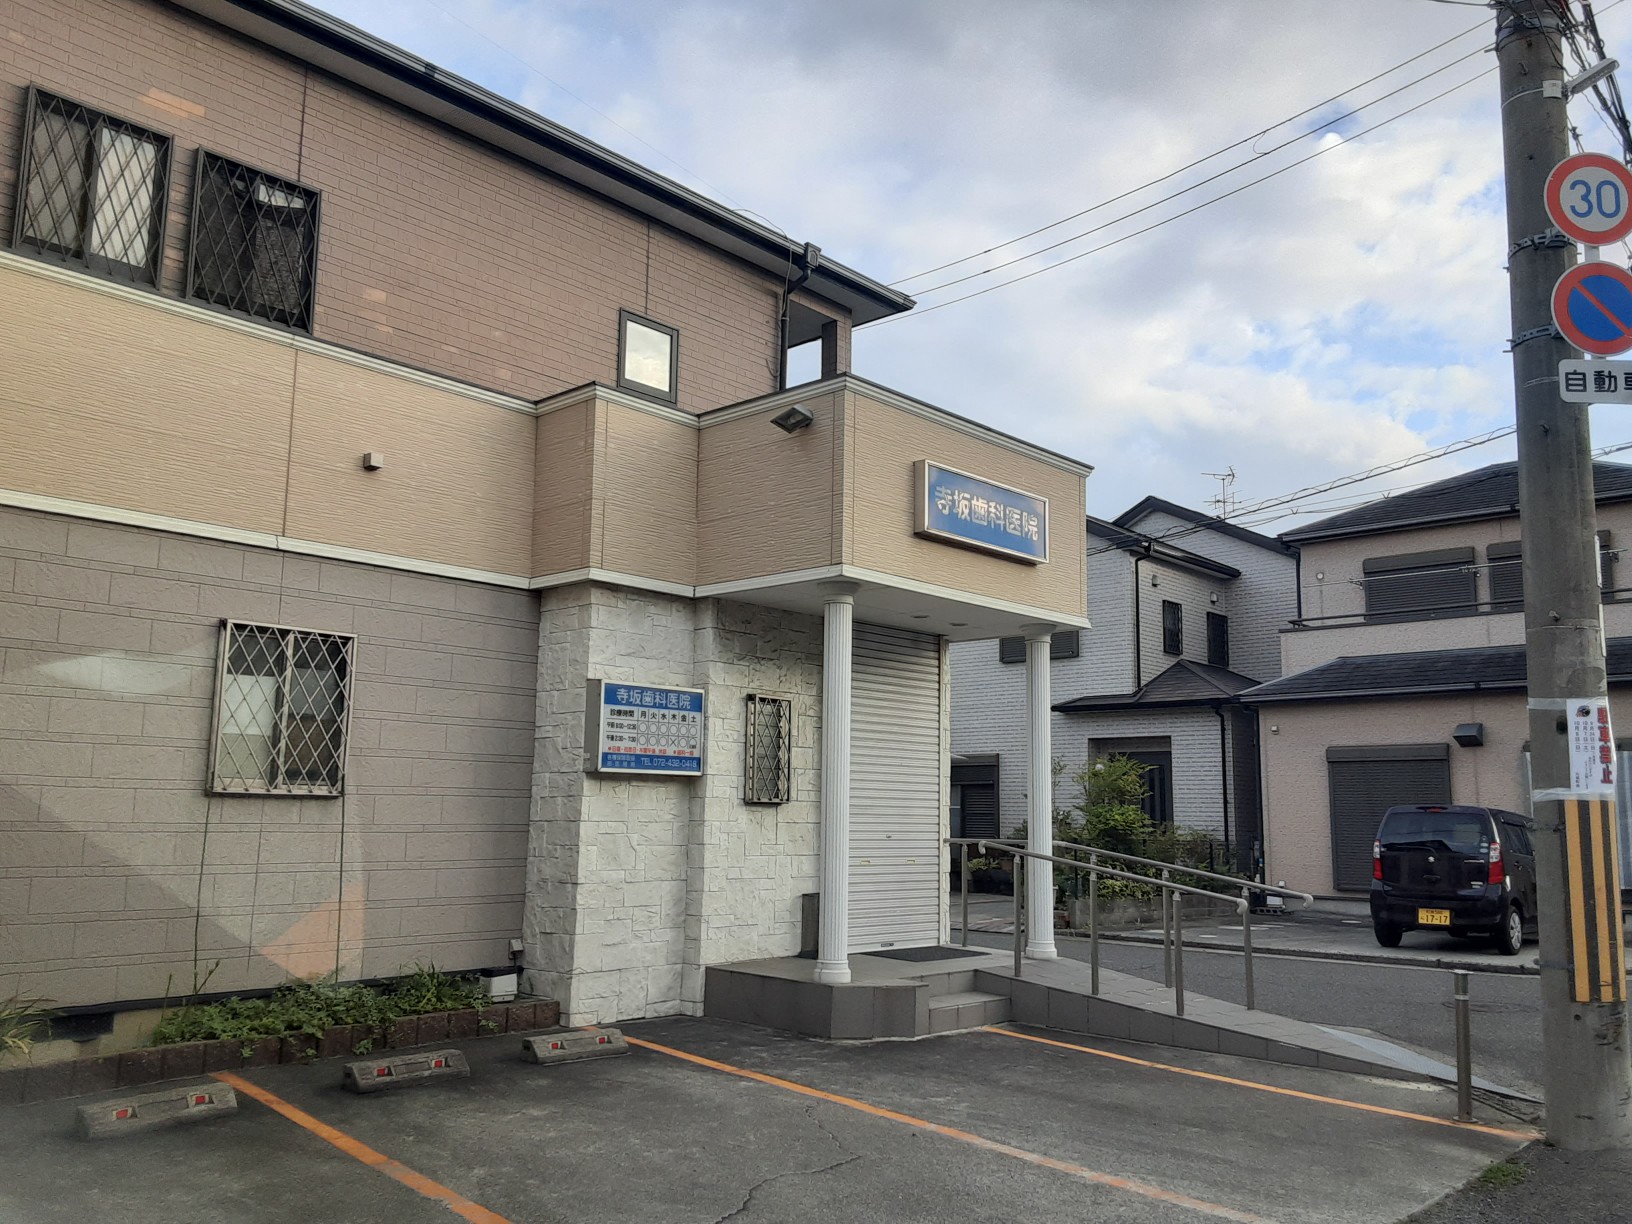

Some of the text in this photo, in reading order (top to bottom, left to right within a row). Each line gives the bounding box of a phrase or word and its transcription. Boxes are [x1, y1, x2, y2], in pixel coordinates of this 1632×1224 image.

[1569, 179, 1621, 219] 30
[934, 485, 1039, 541] 寺坂歯科医院
[616, 688, 691, 709] 寺坂歯科医院
[610, 708, 635, 718] 診療時間
[640, 710, 647, 719] 月
[680, 714, 687, 722] 金
[640, 758, 652, 766] TEL
[653, 758, 697, 768] 072-432-0418
